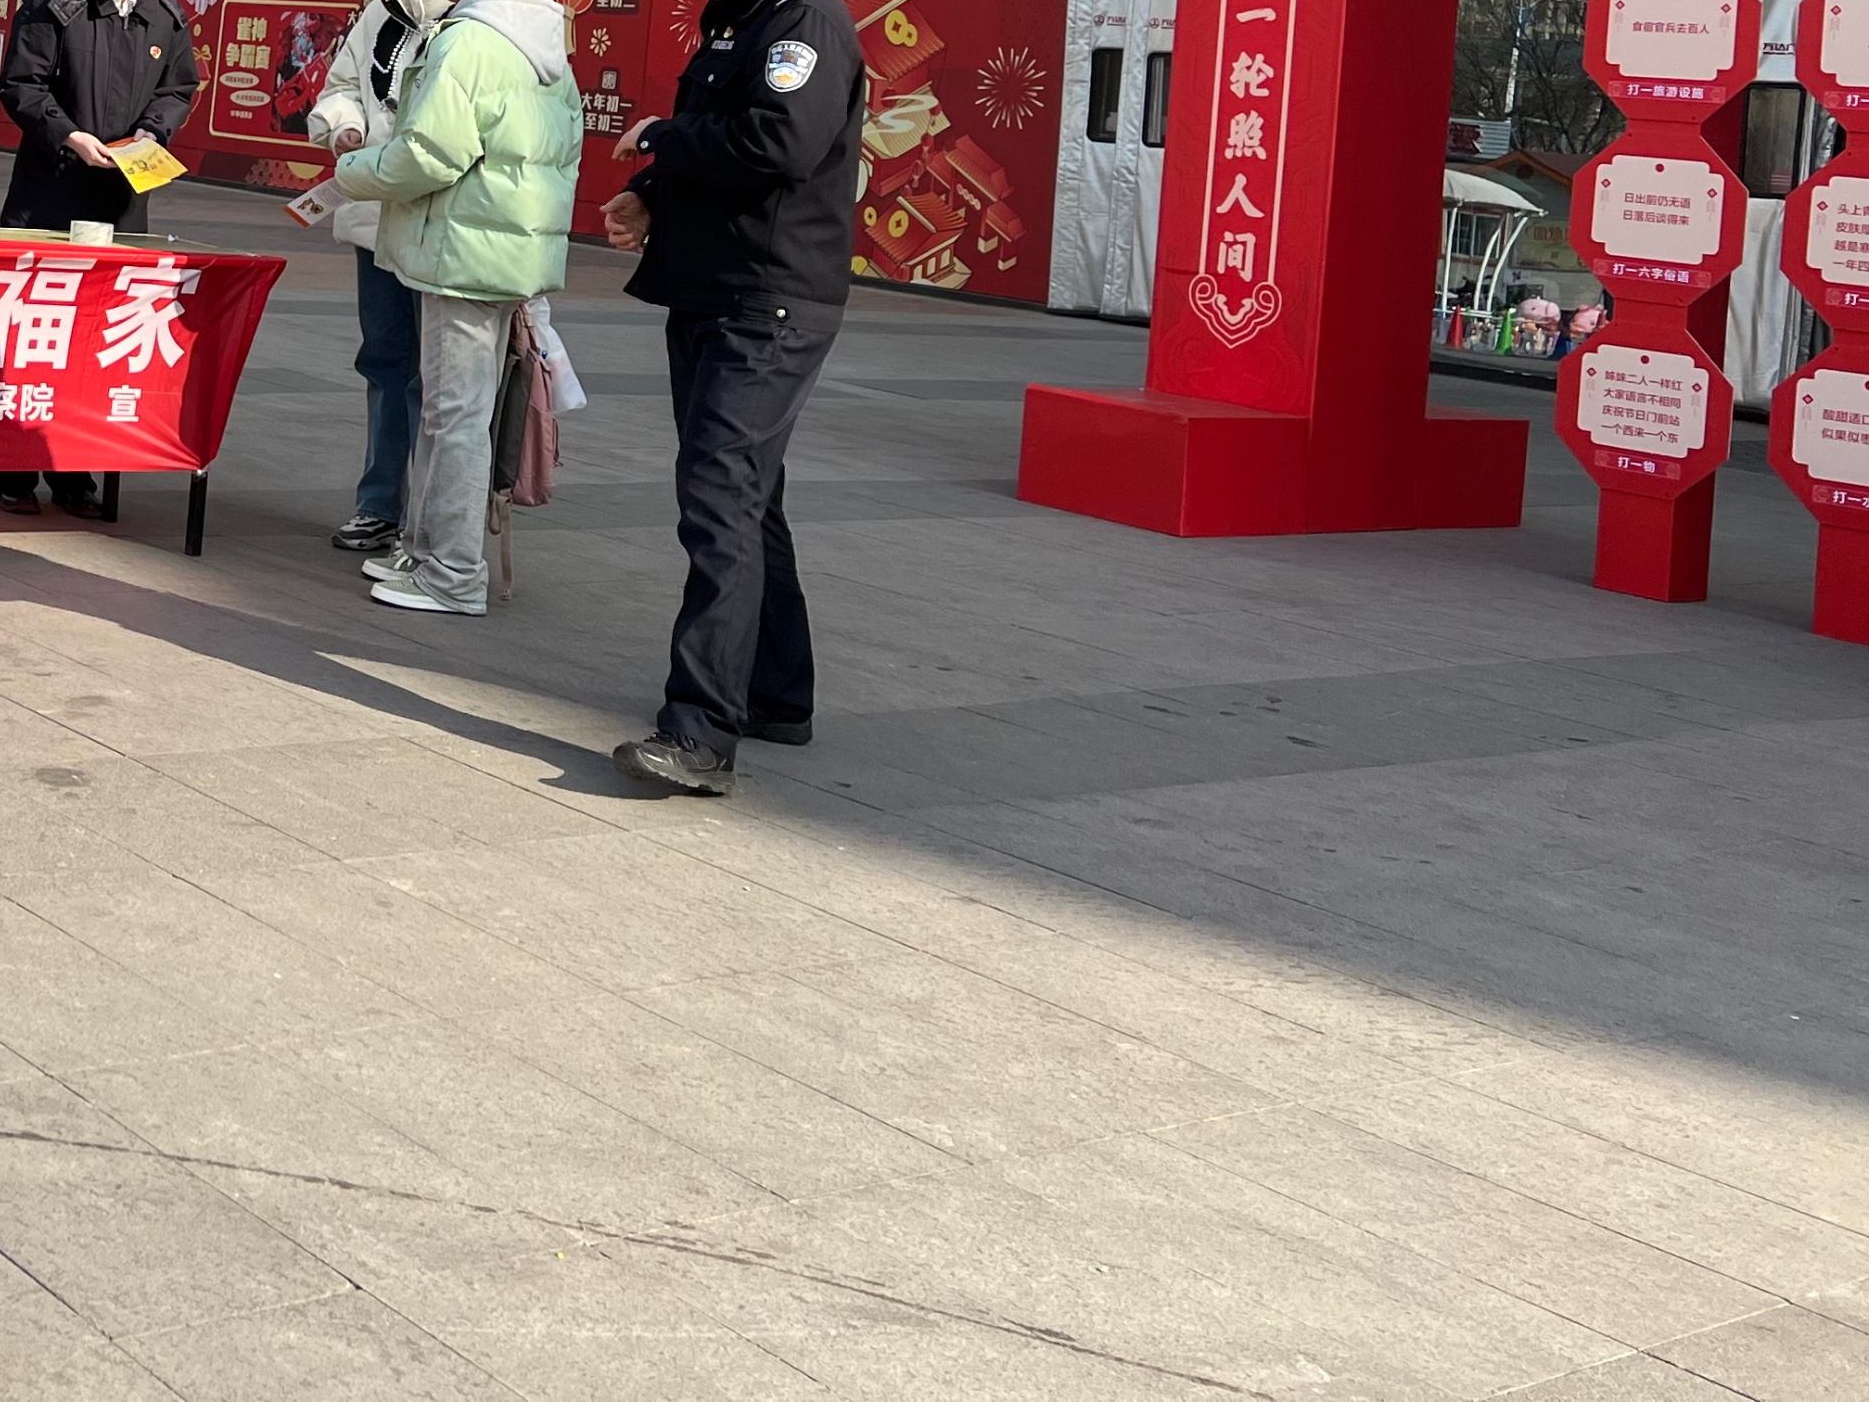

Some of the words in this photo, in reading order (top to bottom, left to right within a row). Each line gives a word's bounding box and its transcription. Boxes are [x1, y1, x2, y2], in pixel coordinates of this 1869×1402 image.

[237, 16, 268, 42] 雀神
[581, 91, 633, 111] 大年初一
[1627, 83, 1704, 100] 打一旅游设施
[583, 111, 624, 134] 至初三
[1624, 192, 1692, 210] 日出前仍无语
[1622, 209, 1690, 226] 日落后谈得来
[1612, 262, 1690, 284] 打一六字俗语
[105, 384, 142, 424] 宣
[1603, 387, 1682, 409] 大家语言不相同
[1601, 404, 1680, 427] 庆祝节日门前站
[1600, 423, 1679, 444] 一个西来一个东
[1617, 456, 1656, 473] 打一物
